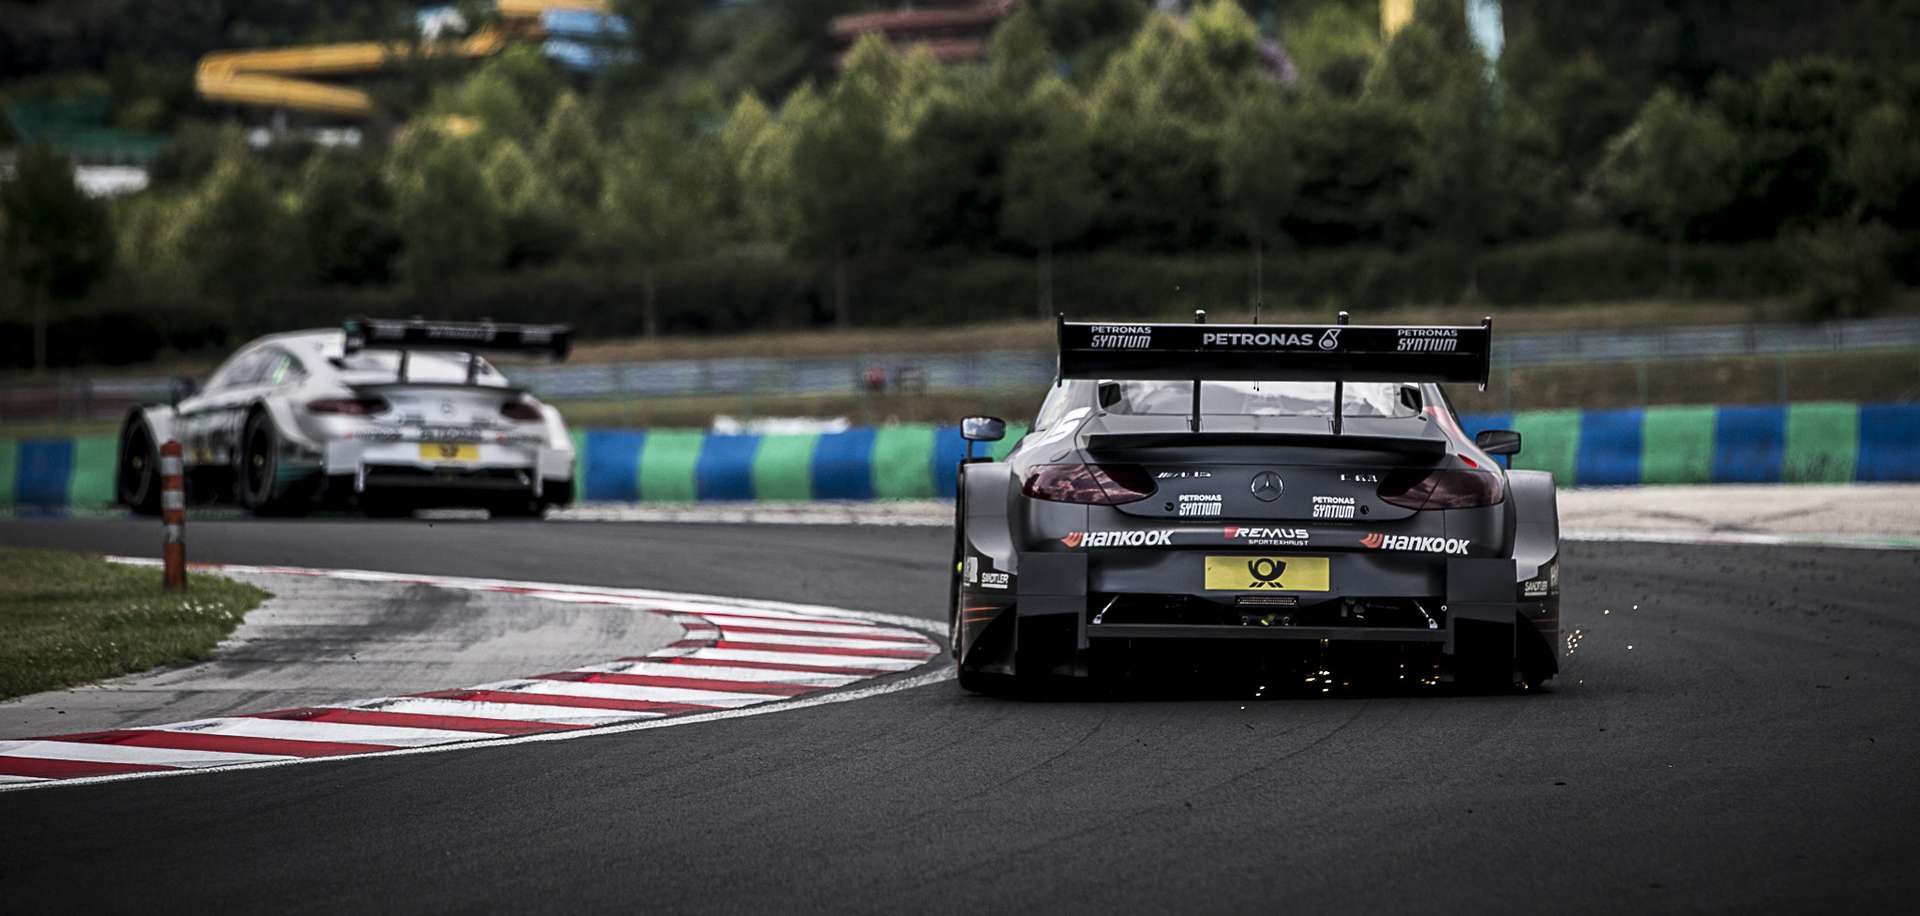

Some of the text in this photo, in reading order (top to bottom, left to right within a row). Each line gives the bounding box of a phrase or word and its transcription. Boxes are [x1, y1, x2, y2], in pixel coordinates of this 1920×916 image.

[1091, 326, 1152, 334] PETRONAS
[1398, 329, 1458, 337] PETRONAS
[1091, 335, 1151, 348] SYNTIUM
[1203, 333, 1313, 345] PETRONAS
[1397, 338, 1457, 351] SYNTIUM
[1179, 494, 1222, 502] PETRONAS
[1312, 496, 1355, 504] PETRONAS
[1179, 502, 1222, 516] SYNTIUM
[1312, 504, 1355, 519] SYNTIUM
[1080, 529, 1175, 547] HANKOOK
[1234, 527, 1309, 538] REMUS
[1381, 535, 1470, 554] HANKOOK
